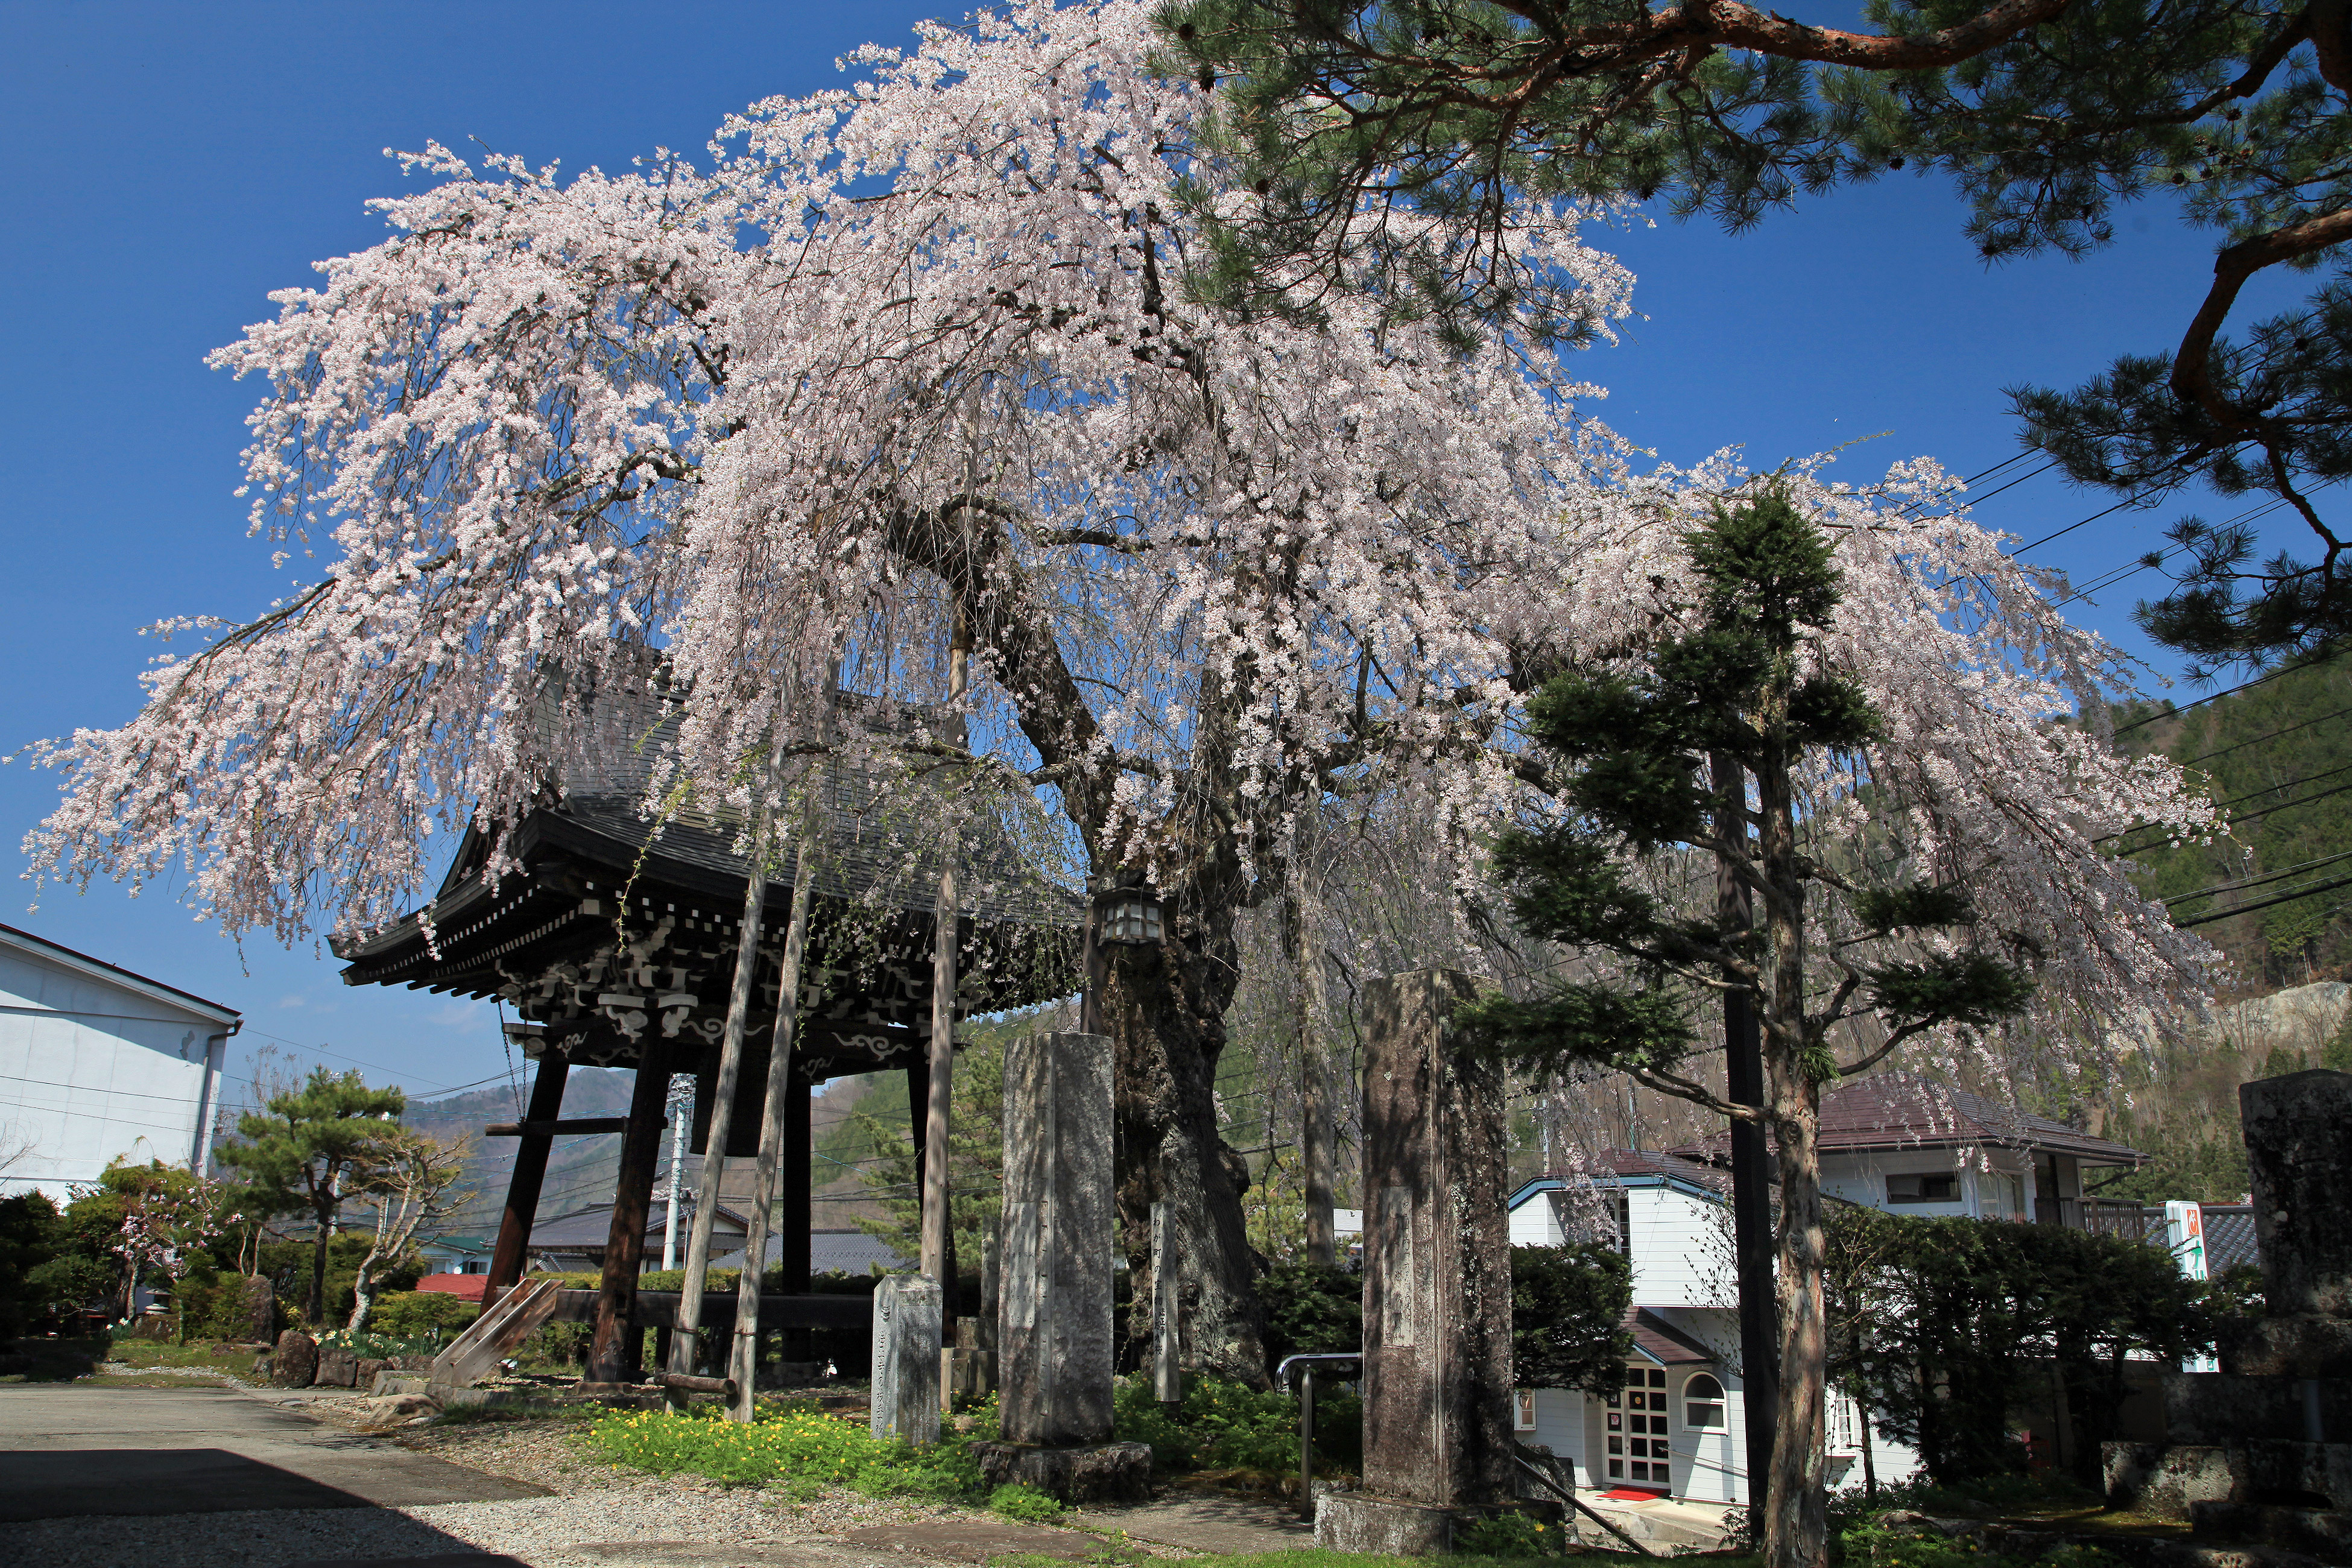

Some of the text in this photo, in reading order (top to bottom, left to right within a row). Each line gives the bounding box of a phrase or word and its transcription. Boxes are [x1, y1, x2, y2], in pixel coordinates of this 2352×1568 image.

[1152, 1218, 1163, 1356] わが町の宝物しだれ桜
